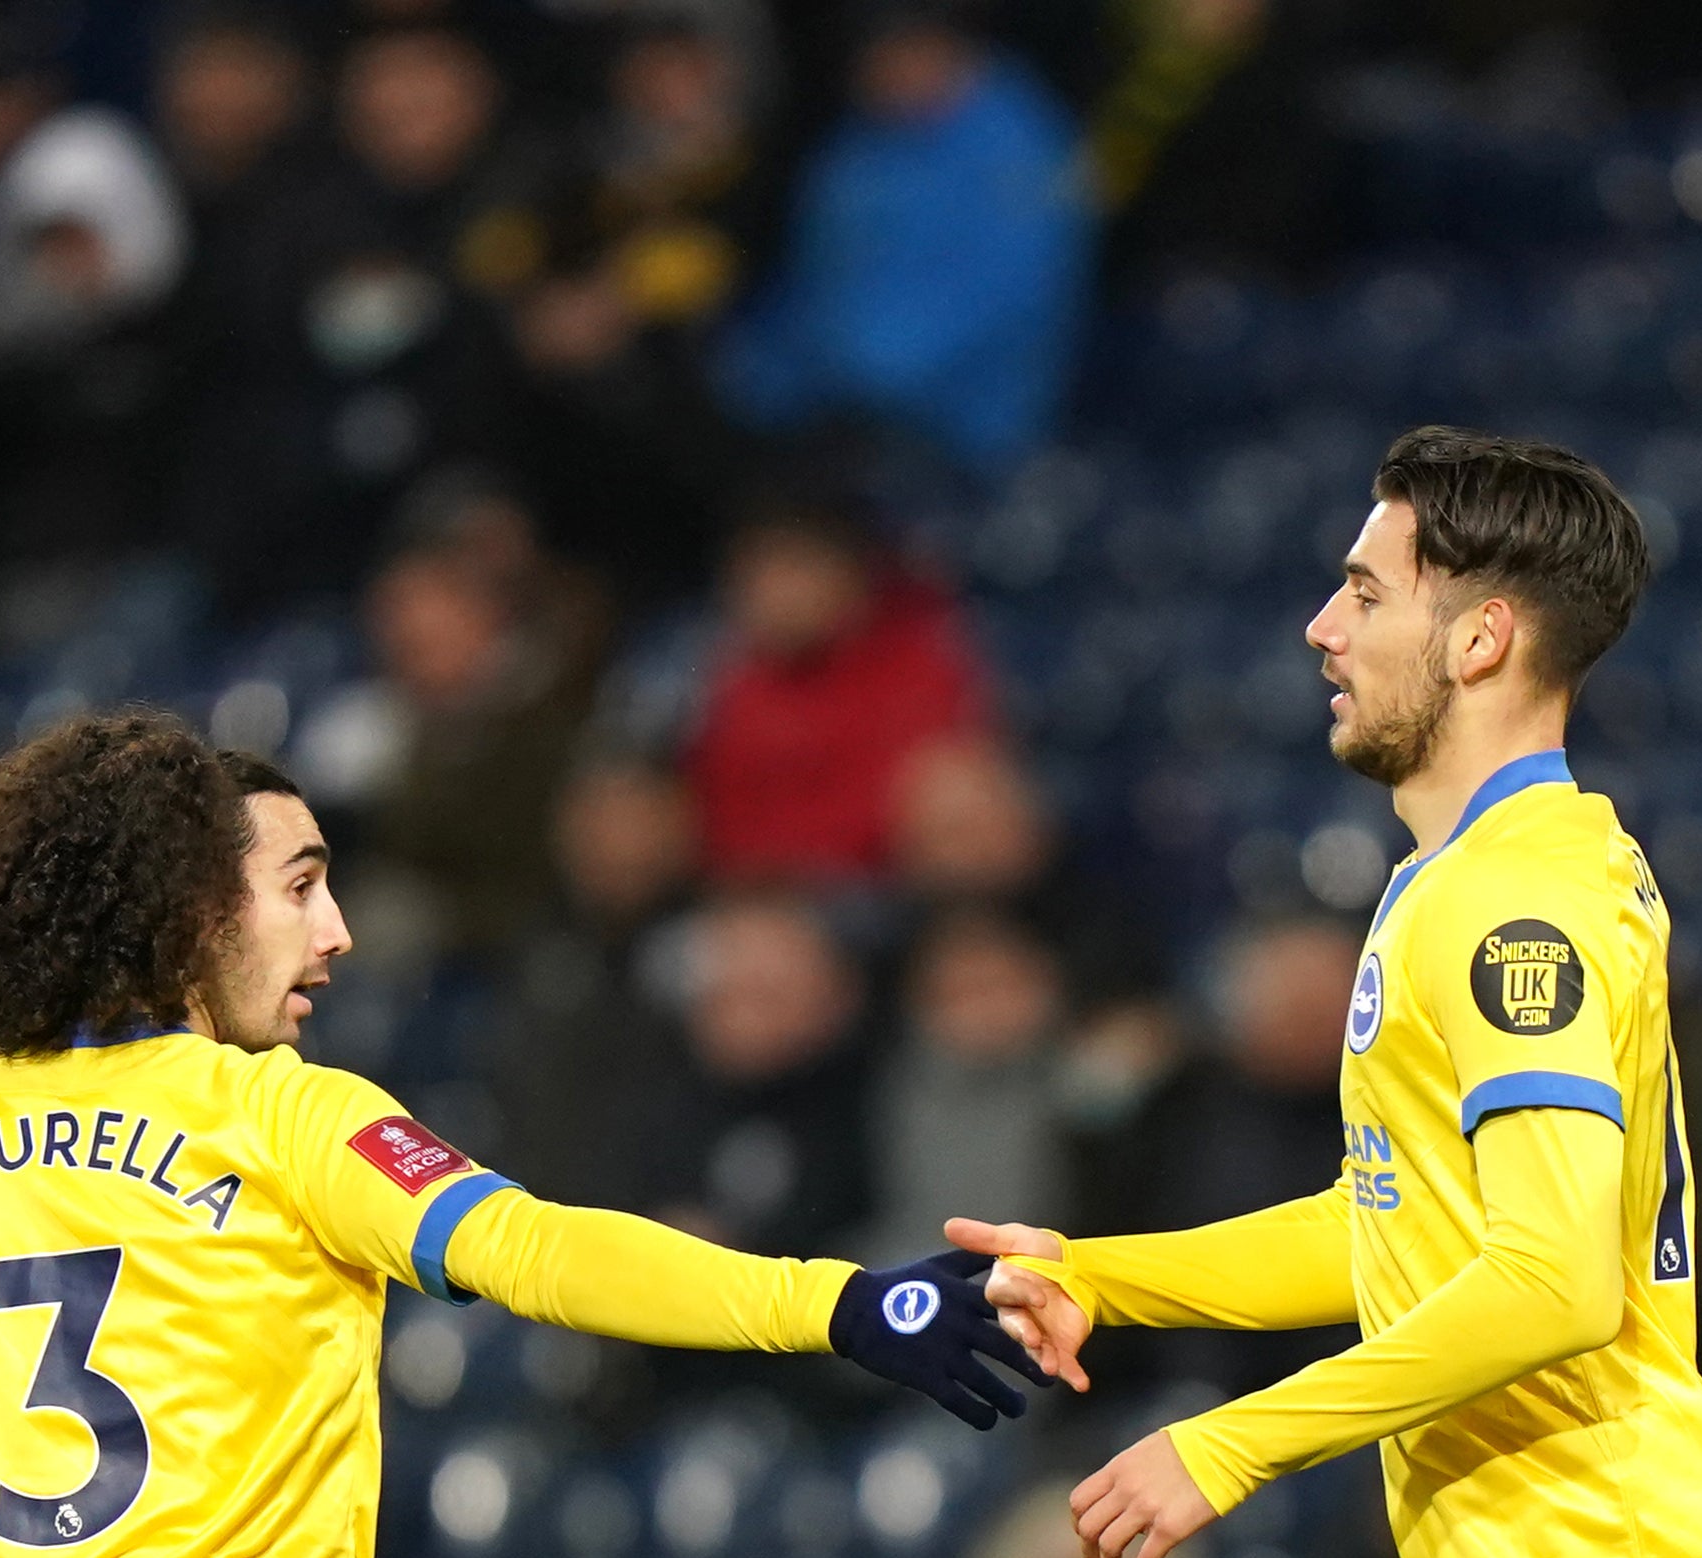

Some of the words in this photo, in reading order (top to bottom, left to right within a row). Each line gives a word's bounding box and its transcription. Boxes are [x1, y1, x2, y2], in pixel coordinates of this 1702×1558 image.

[1485, 935, 1570, 965] SNICKERS
[1510, 968, 1549, 1002] UK
[394, 1146, 443, 1170] Emirates
[402, 1163, 425, 1178] FA
[421, 1151, 450, 1166] CUP
